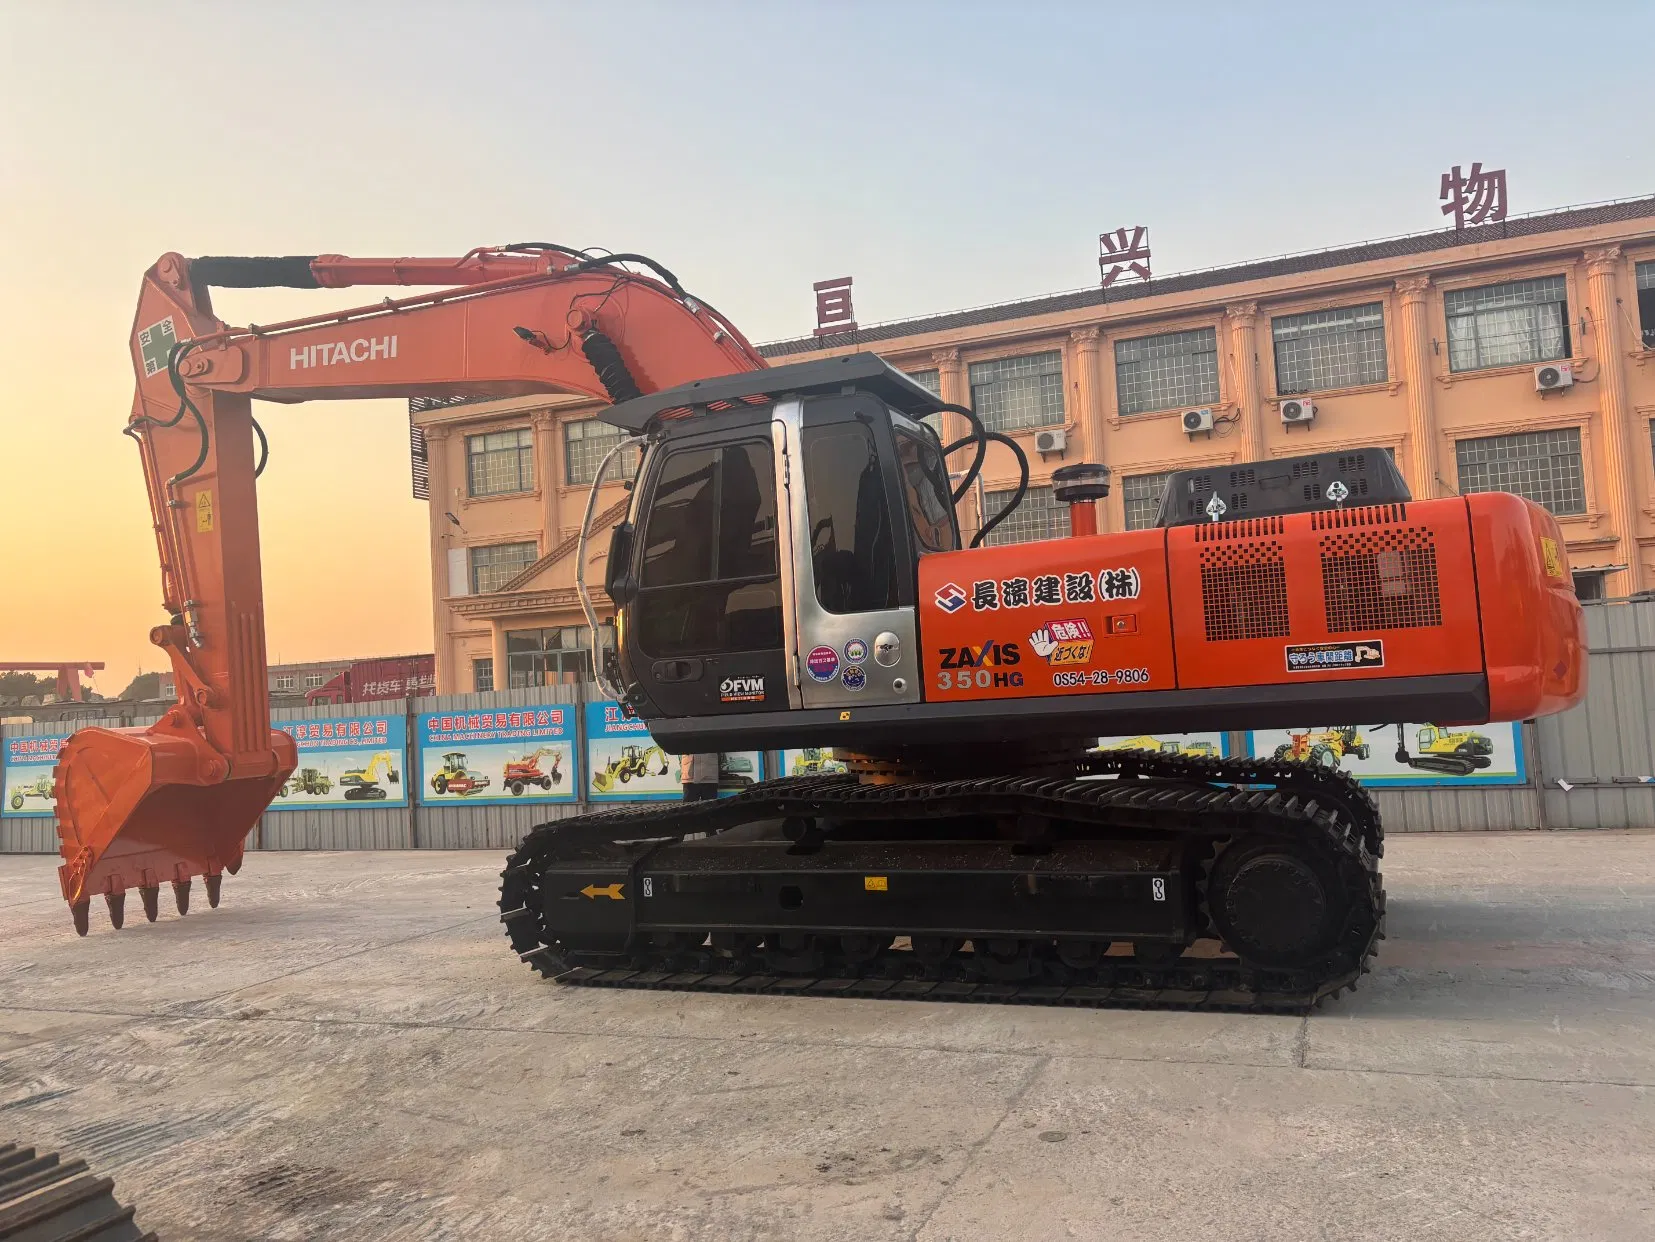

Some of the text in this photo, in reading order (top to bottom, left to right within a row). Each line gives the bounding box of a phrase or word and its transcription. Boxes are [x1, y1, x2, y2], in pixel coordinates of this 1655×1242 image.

[1099, 226, 1152, 287] 兴
[1440, 162, 1507, 228] 物
[290, 335, 398, 370] HITACHI
[939, 640, 1021, 669] ZAXIS
[428, 709, 563, 731] 中国机械贸易有限公司
[428, 732, 452, 742] CHINA
